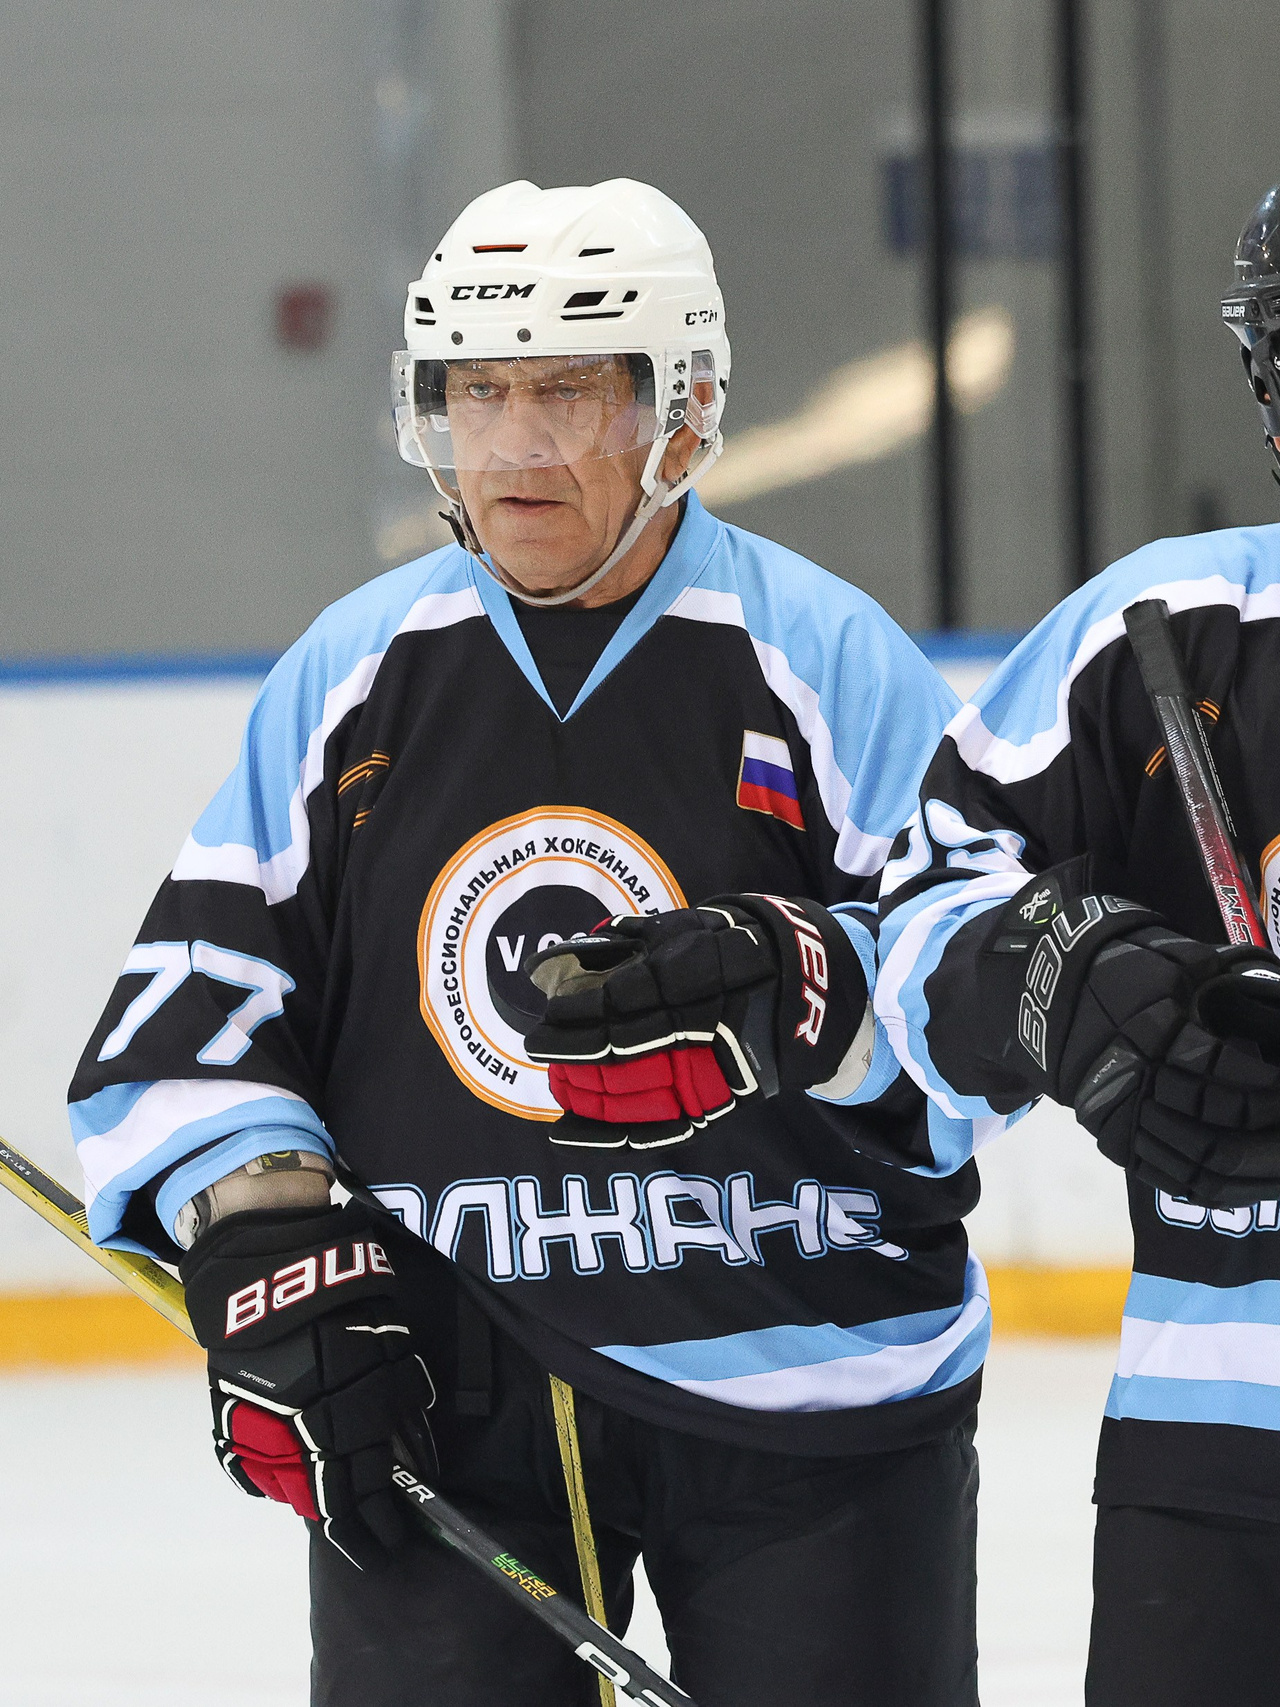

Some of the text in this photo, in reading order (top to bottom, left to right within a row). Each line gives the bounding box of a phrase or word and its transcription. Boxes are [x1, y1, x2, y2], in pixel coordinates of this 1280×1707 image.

[450, 283, 536, 301] CCM
[441, 836, 651, 1085] НЕПРОФЕССИОНАЛЬНАЯ ХОКЕЙНАЯ
[496, 934, 526, 973] V
[741, 892, 829, 1047] UER
[96, 939, 297, 1066] 77
[237, 1369, 277, 1390] SUPREME
[391, 1464, 436, 1504] ER
[490, 1556, 542, 1602] SONIC
[499, 1552, 557, 1598] ULTRA
